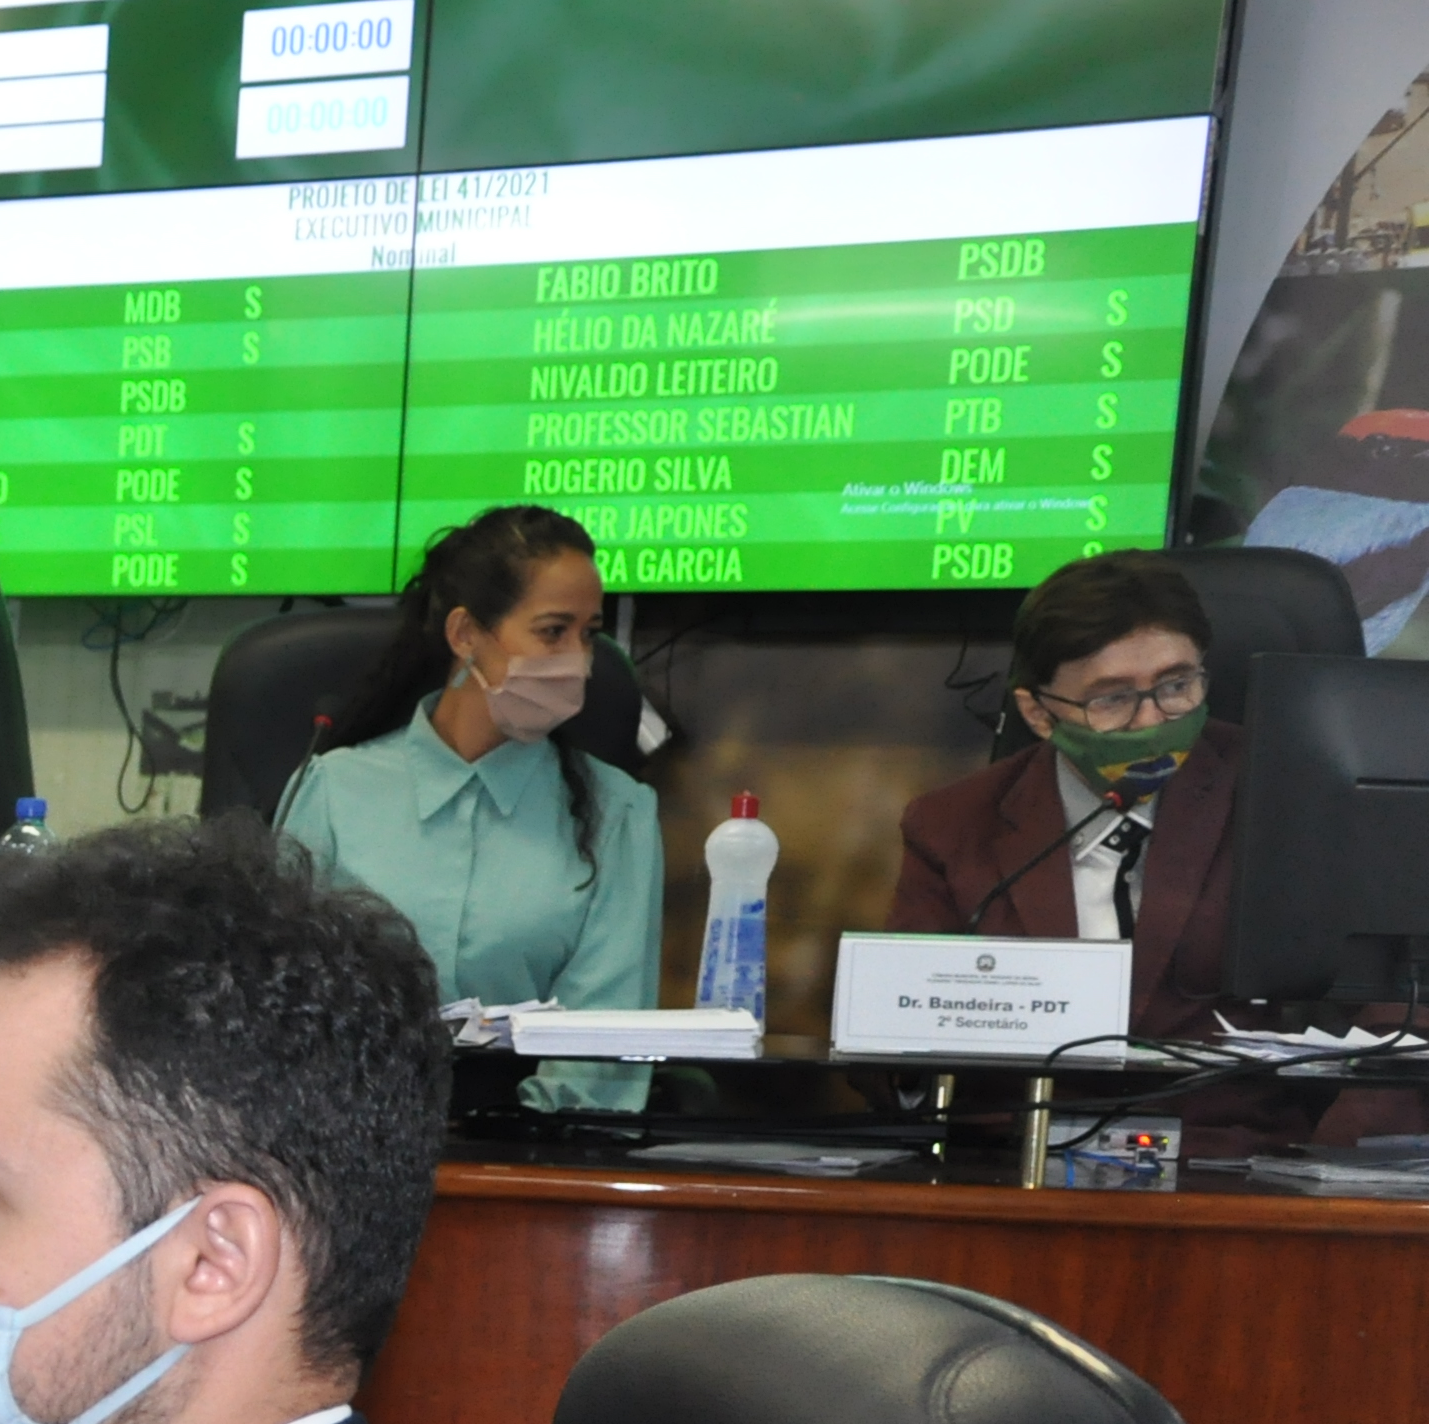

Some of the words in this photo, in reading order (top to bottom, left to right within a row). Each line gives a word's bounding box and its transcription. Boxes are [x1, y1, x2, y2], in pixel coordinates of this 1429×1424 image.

[271, 17, 393, 57] 00:00:00
[288, 181, 377, 210] PROJETO
[385, 178, 410, 206] DE
[417, 176, 449, 203] LEI
[456, 170, 550, 201] 41/2021
[294, 211, 409, 241] EXECUTIVO
[416, 204, 532, 234] MUNICIPAL
[536, 263, 621, 302] FABIO
[630, 258, 719, 297] BRITO
[957, 238, 1045, 280] PSDB
[124, 289, 181, 324] MDB
[244, 285, 262, 320] S
[533, 307, 613, 353] HÉLIO
[621, 312, 657, 350] DA
[666, 297, 778, 348] NAZARÉ
[953, 295, 1016, 334] PSD
[1106, 289, 1129, 326] S
[122, 333, 172, 369] PSB
[242, 331, 260, 364] S
[530, 362, 648, 400] NIVALDO
[656, 356, 778, 396] LEITEIRO
[948, 345, 1032, 385] PODE
[1100, 341, 1123, 378] S
[120, 378, 186, 413] PSDB
[527, 408, 688, 447] PROFESSOR
[696, 403, 855, 444] SEBASTIAN
[944, 397, 1002, 434] PTB
[1095, 392, 1118, 429] S
[117, 423, 168, 458] PDT
[238, 421, 255, 455] S
[116, 467, 181, 502] PODE
[235, 466, 253, 500] S
[523, 457, 647, 494] ROGERIO
[654, 455, 732, 492] SILVA
[941, 447, 1006, 484] DEM
[1091, 443, 1113, 480] S
[114, 512, 158, 547] PSL
[233, 512, 250, 545] S
[625, 502, 748, 540] JAPONES
[935, 498, 978, 534] PV
[1086, 494, 1108, 531] S
[111, 553, 179, 587] PODE
[231, 553, 248, 586] S
[636, 546, 743, 583] GARCIA
[931, 541, 1014, 579] PSDB
[898, 995, 922, 1009] Dr.
[929, 996, 1013, 1012] Bandeira
[1031, 999, 1070, 1014] PDT
[955, 1016, 1028, 1030] Secretário
